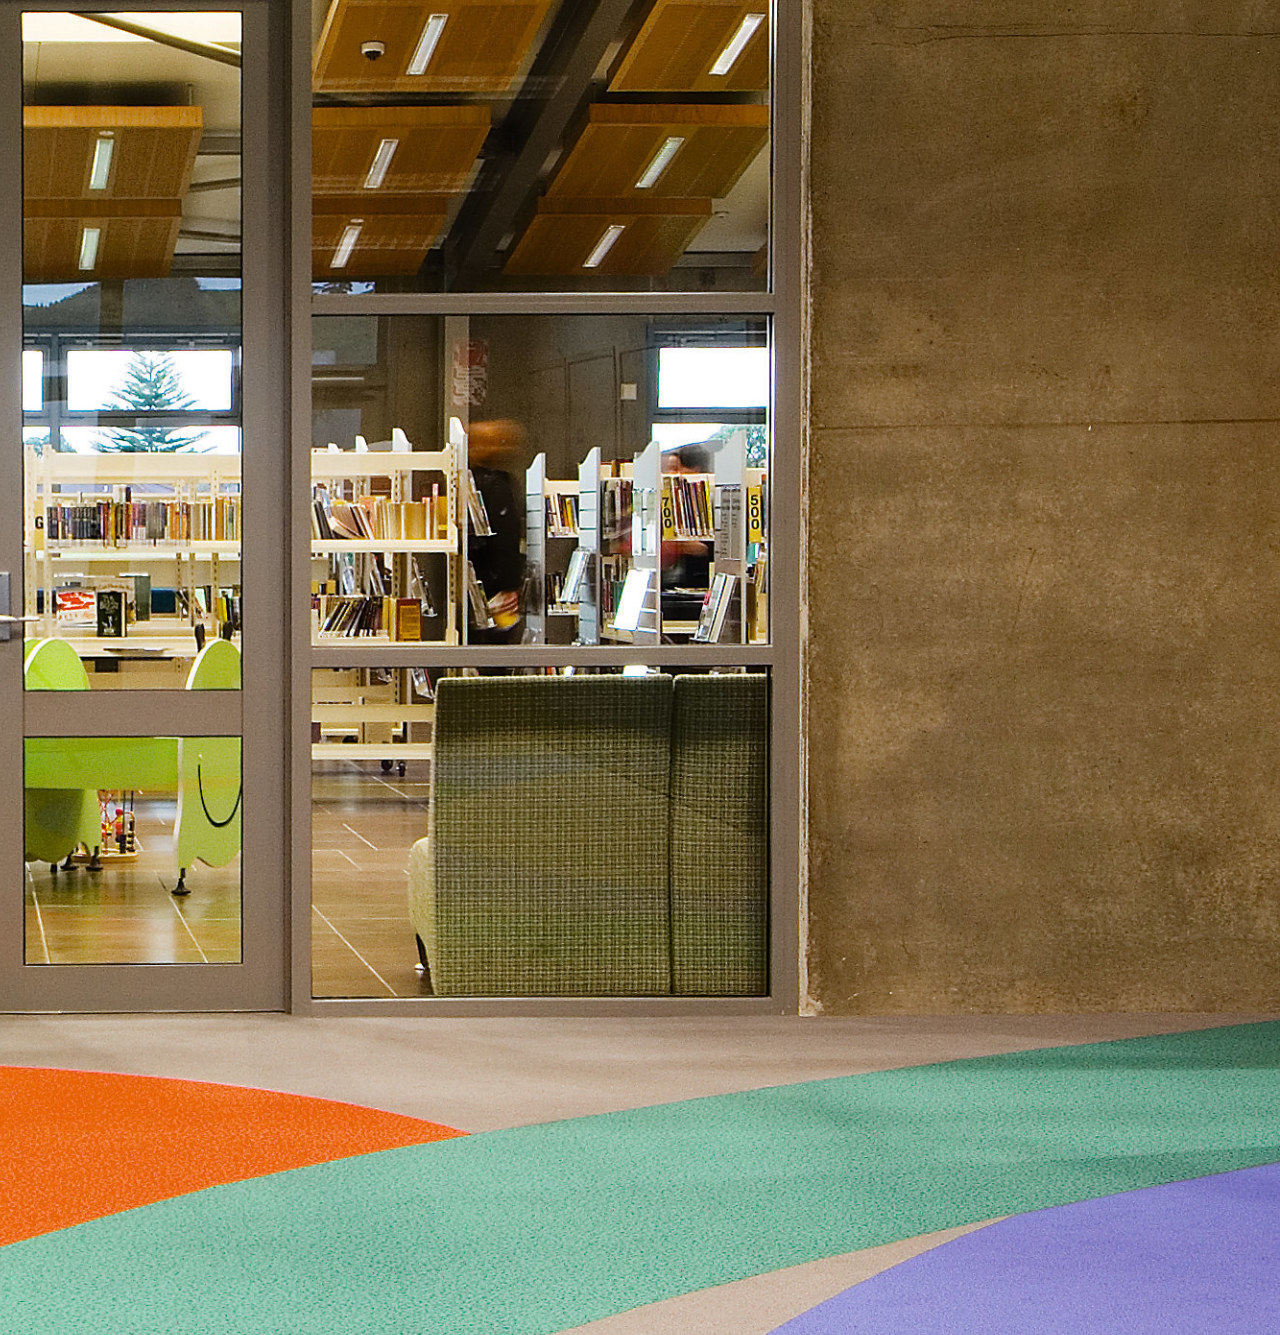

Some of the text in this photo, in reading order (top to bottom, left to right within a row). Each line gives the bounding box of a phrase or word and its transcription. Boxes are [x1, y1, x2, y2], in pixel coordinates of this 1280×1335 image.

[35, 516, 43, 529] G
[662, 497, 672, 528] 700
[750, 495, 760, 530] 500
